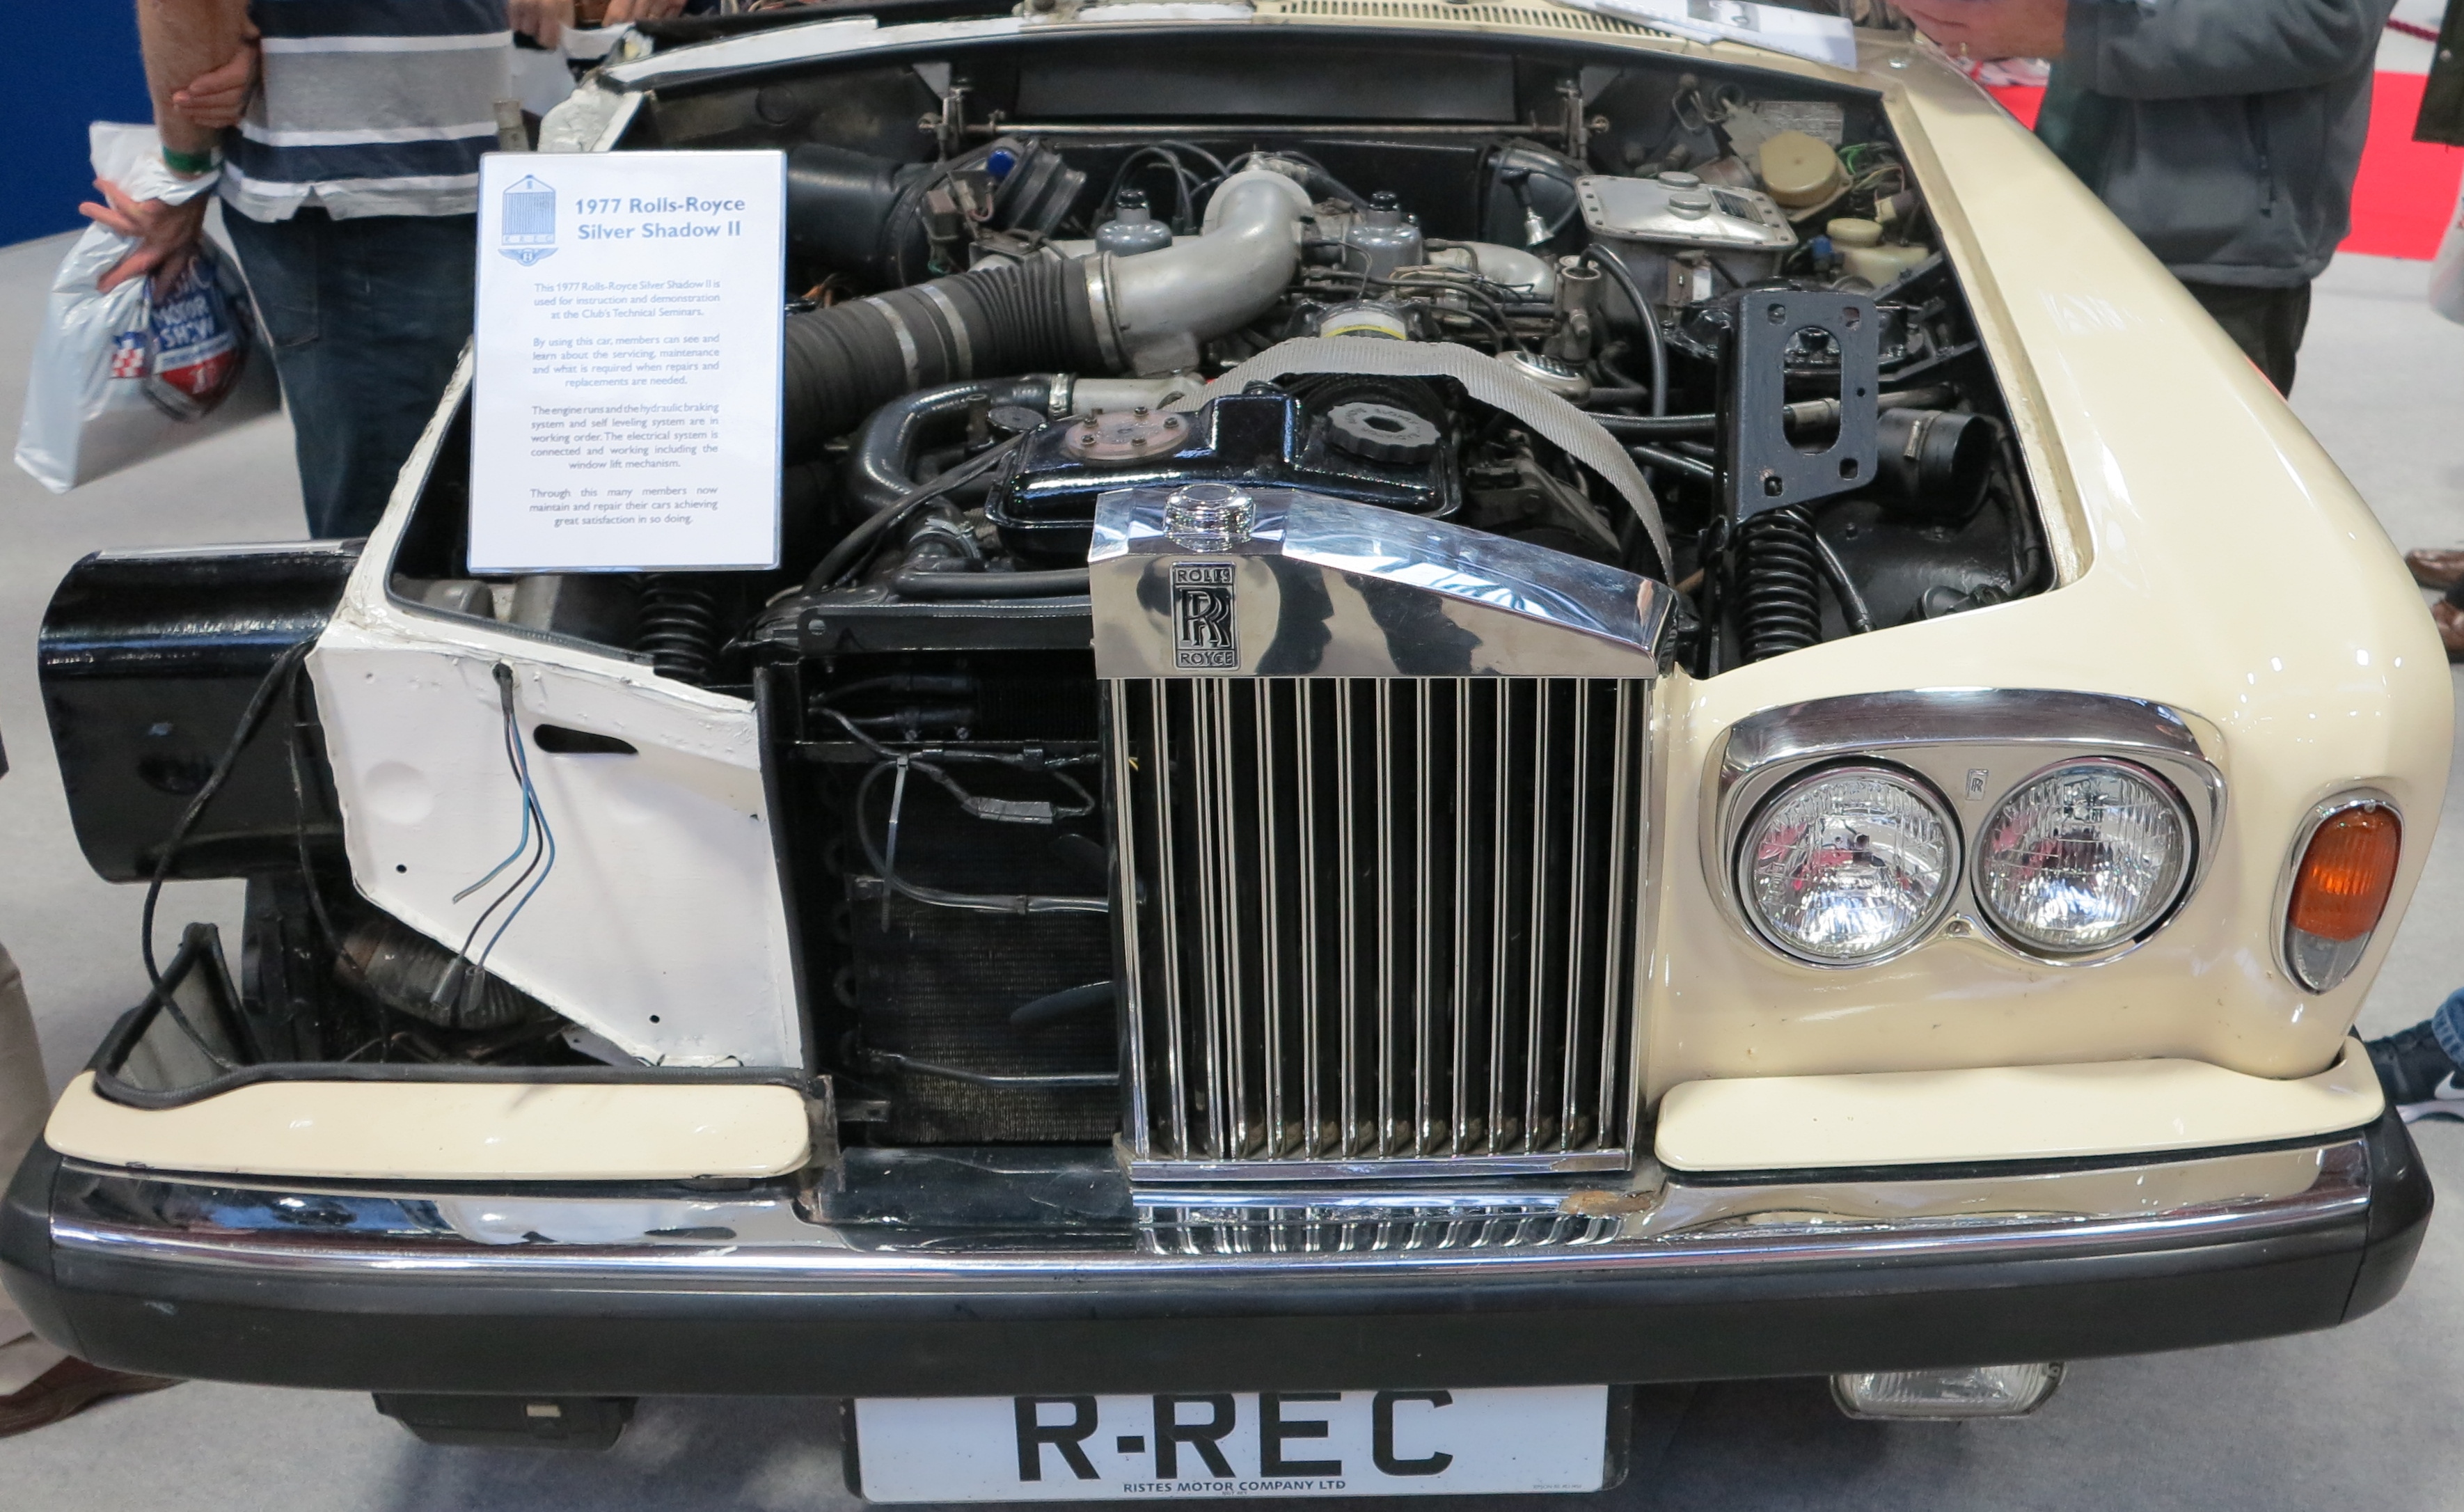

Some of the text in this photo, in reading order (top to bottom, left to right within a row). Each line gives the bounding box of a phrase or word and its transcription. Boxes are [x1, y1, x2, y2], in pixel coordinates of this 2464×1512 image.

[577, 197, 745, 215] 1977 Rolls-Royce
[578, 221, 741, 239] Silver Shadow II
[533, 282, 555, 292] This
[555, 281, 581, 291] 1977
[581, 281, 638, 293] Rolls-Royce
[638, 280, 666, 290] Silver
[665, 279, 705, 289] Shadow
[712, 278, 721, 288] is
[533, 292, 721, 306] used for instruction and demonstration
[551, 306, 704, 319] at the Club's Technical Seminars.
[533, 338, 546, 349] By
[548, 337, 573, 349] using
[576, 336, 594, 346] this
[615, 335, 660, 345] members
[702, 334, 720, 344] and
[532, 350, 557, 360] learn
[561, 349, 588, 360] about
[592, 349, 608, 359] the
[660, 347, 720, 358] maintenance
[532, 361, 720, 375] and what is required when repairs and
[565, 376, 629, 388] replacements
[650, 375, 687, 385] needed.
[531, 406, 551, 415] The
[551, 405, 583, 417] engine
[605, 404, 624, 414] and
[623, 404, 640, 414] the
[640, 404, 684, 416] hydraulic
[684, 403, 720, 415] braking
[531, 419, 564, 431] system
[569, 418, 587, 428] and
[591, 418, 608, 428] self
[612, 418, 647, 430] leveling
[651, 417, 685, 429] system
[710, 416, 719, 426] in
[530, 430, 719, 445] working order. The electrical system is
[530, 443, 719, 457] connected and working including the
[568, 458, 681, 469] window lift mechanism.
[529, 487, 571, 499] Through
[580, 487, 599, 496] this
[606, 489, 633, 498] many
[641, 485, 688, 496] members
[529, 501, 570, 511] maintain
[573, 501, 591, 510] and
[593, 501, 623, 512] repair
[625, 500, 649, 510] their
[674, 499, 718, 511] achieving
[554, 515, 579, 527] great
[582, 514, 635, 525] satisfaction
[638, 514, 647, 523] in
[1177, 569, 1231, 583] ROLLS
[1180, 651, 1233, 666] ROYCE
[1014, 1388, 1454, 1483] R-REC
[1123, 1480, 1346, 1493] RISTES MOTOR COMPANY LTD
